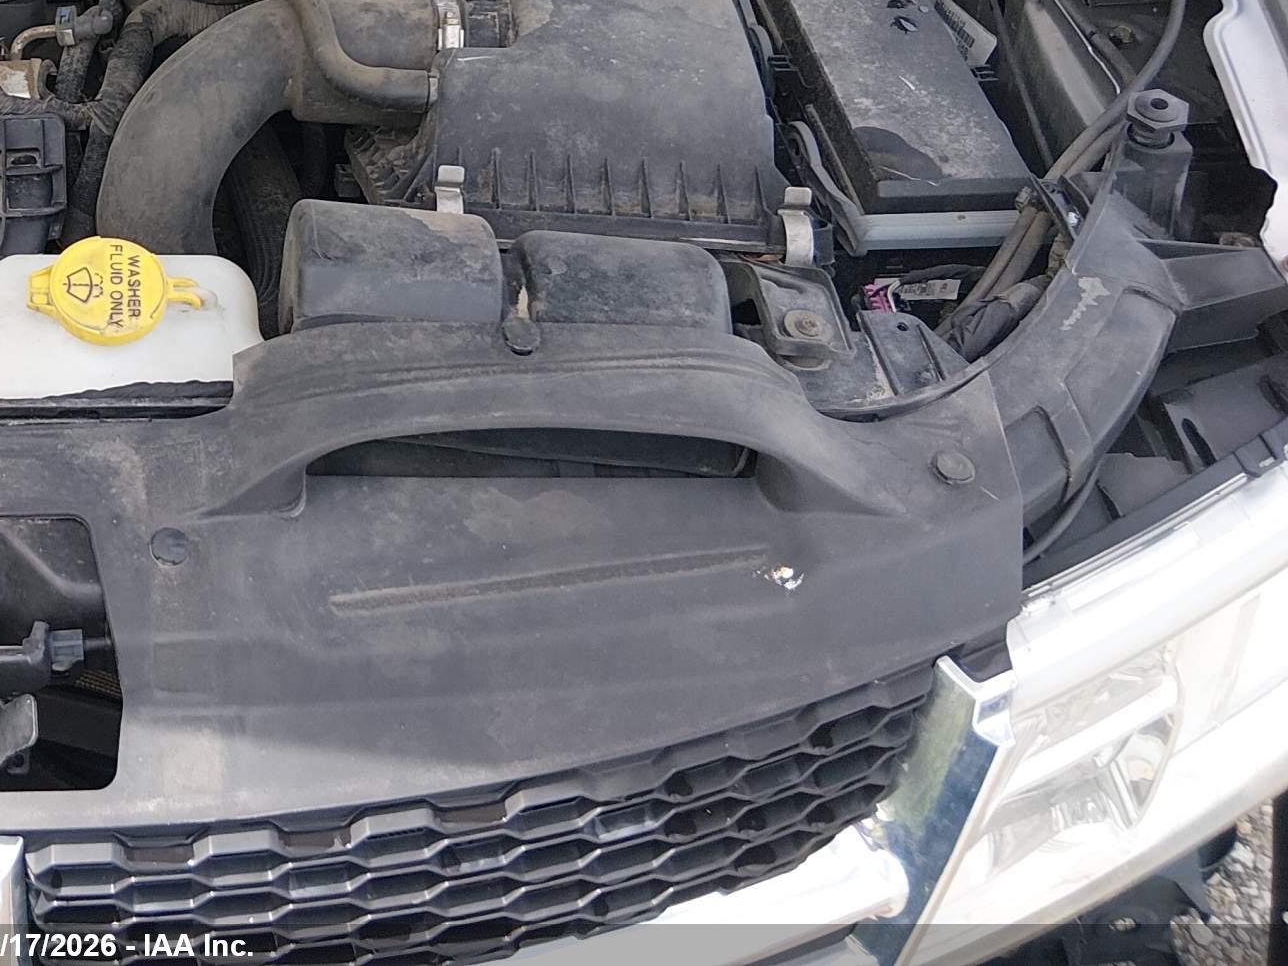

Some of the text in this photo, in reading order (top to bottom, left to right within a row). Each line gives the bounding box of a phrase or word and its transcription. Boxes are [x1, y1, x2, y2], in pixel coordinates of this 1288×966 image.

[109, 244, 125, 329] FLUID ONLY
[127, 254, 142, 319] WASHER
